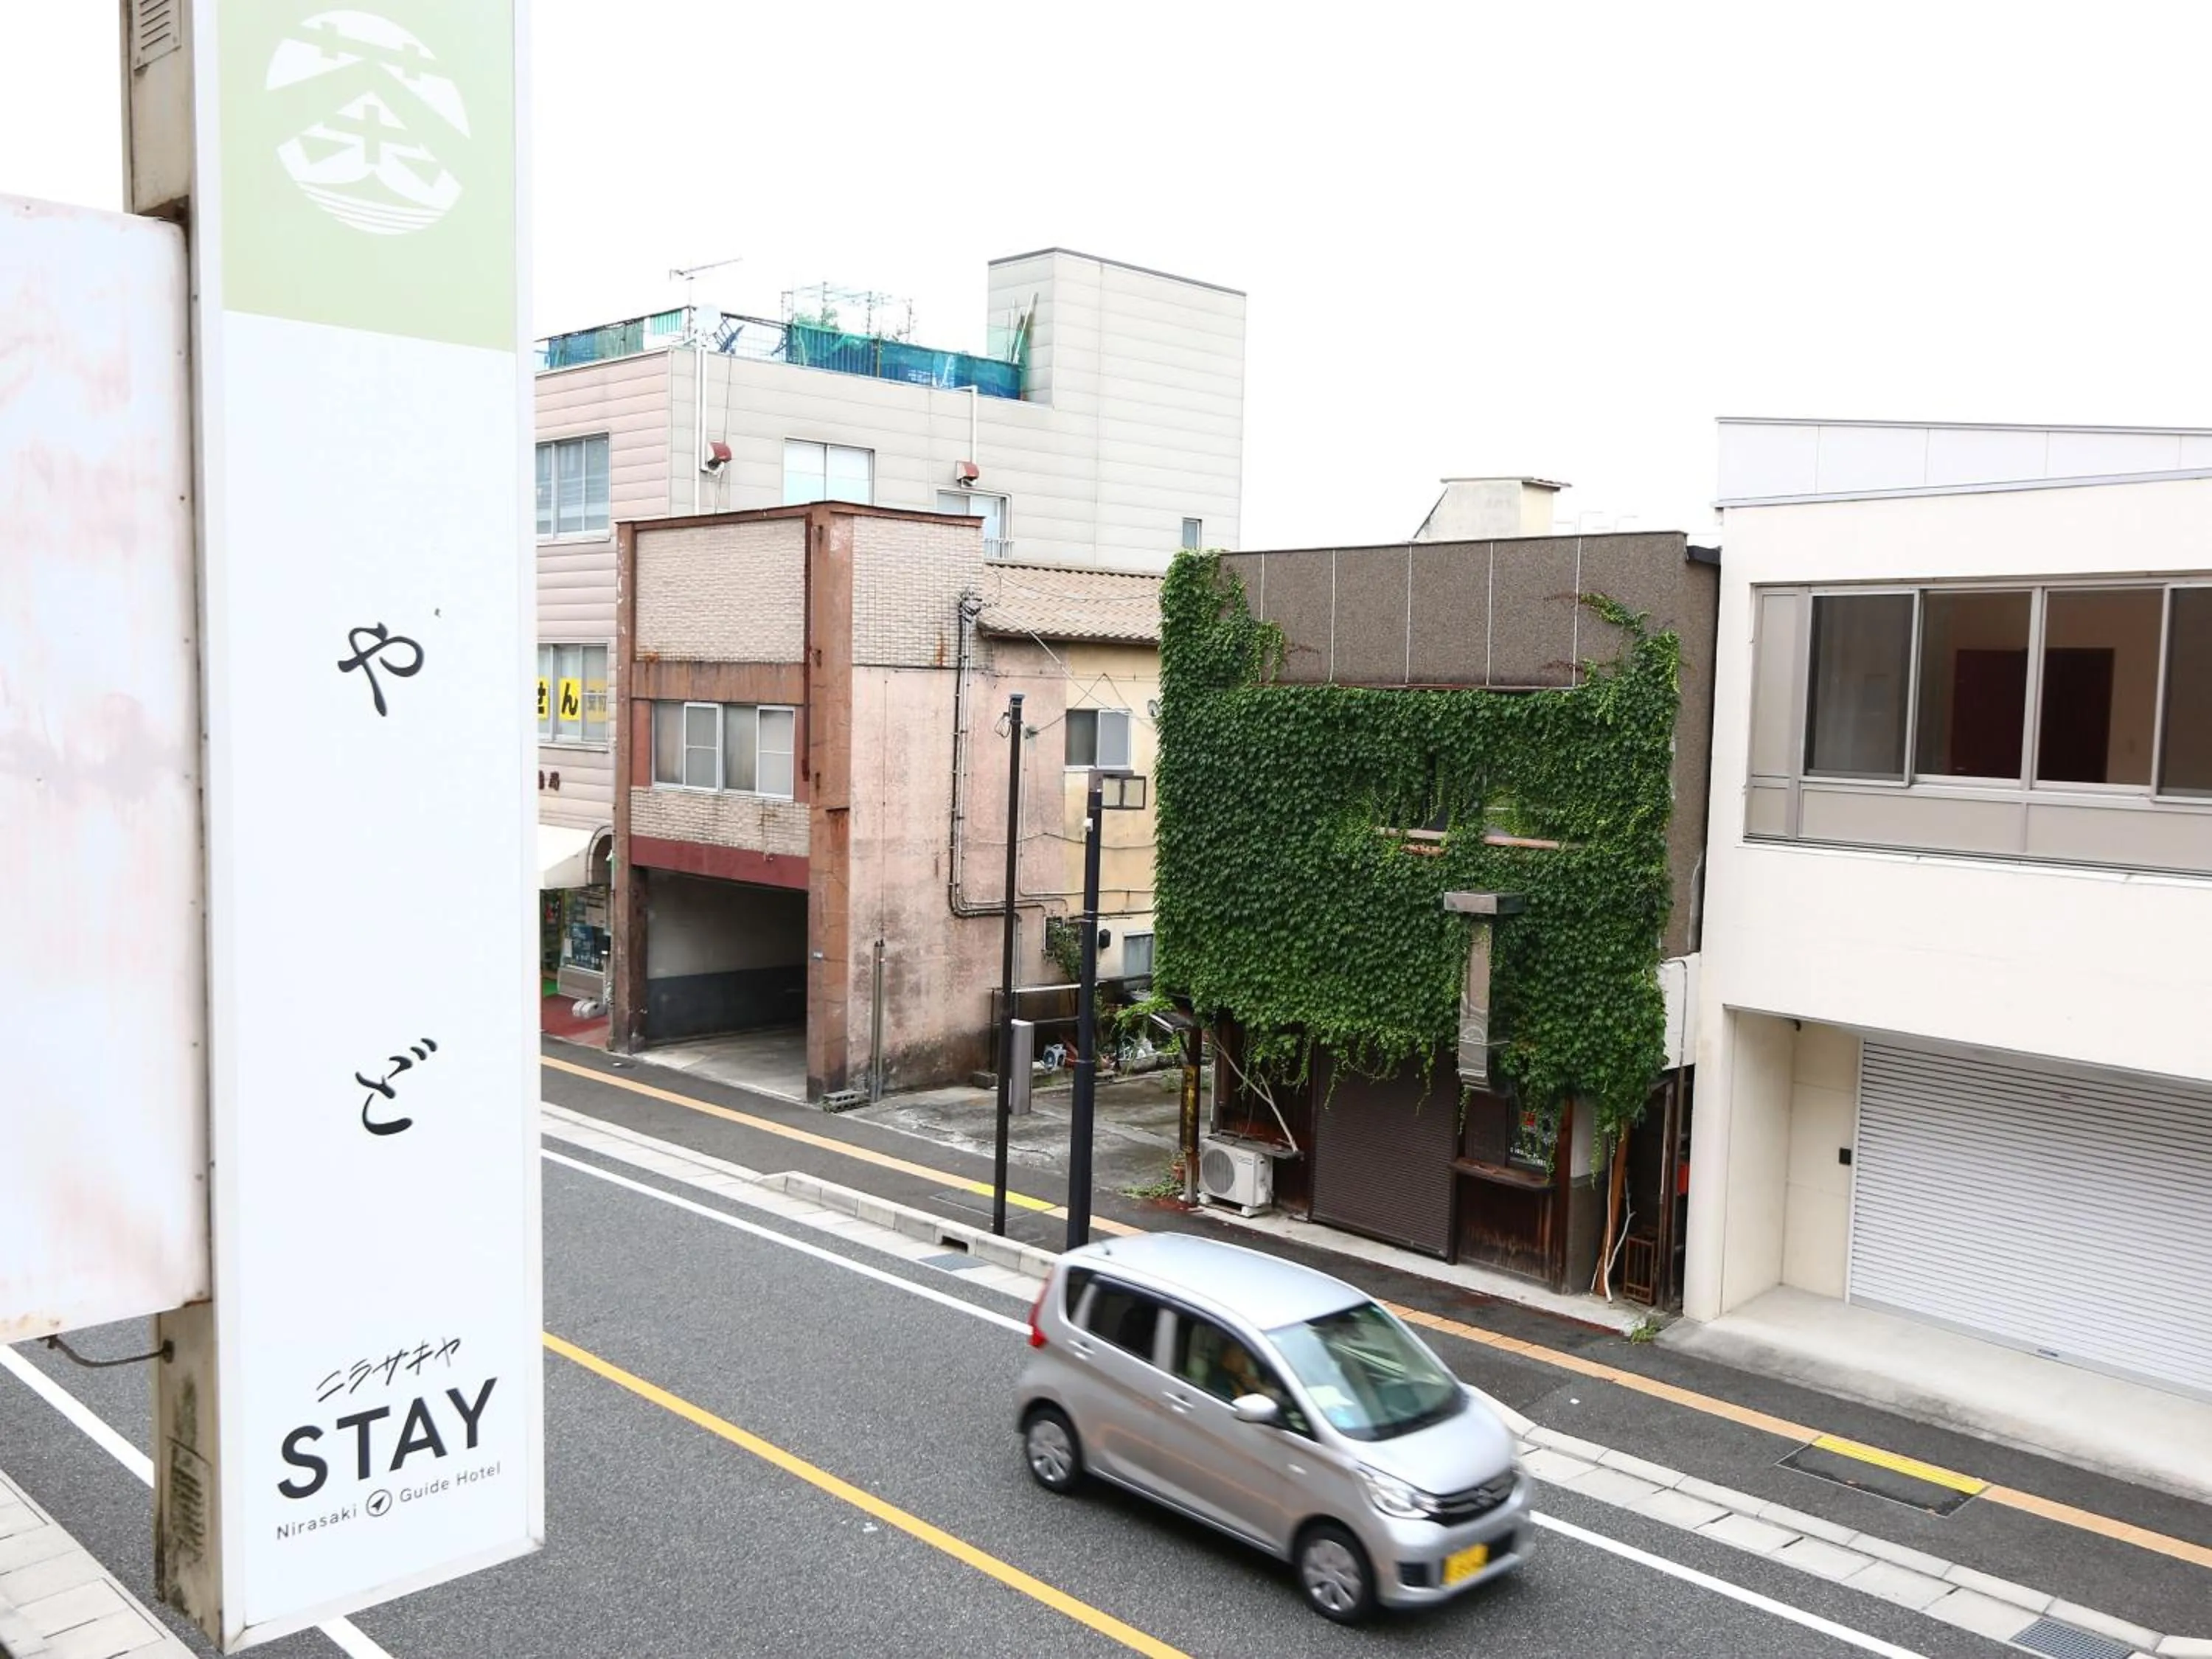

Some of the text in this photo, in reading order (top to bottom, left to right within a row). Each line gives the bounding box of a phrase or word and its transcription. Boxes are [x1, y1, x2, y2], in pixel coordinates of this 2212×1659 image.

[316, 1337, 462, 1403] ニラサキヤ
[276, 1377, 498, 1500] STAY
[276, 1461, 501, 1540] Nirasaki Guide Hotel
